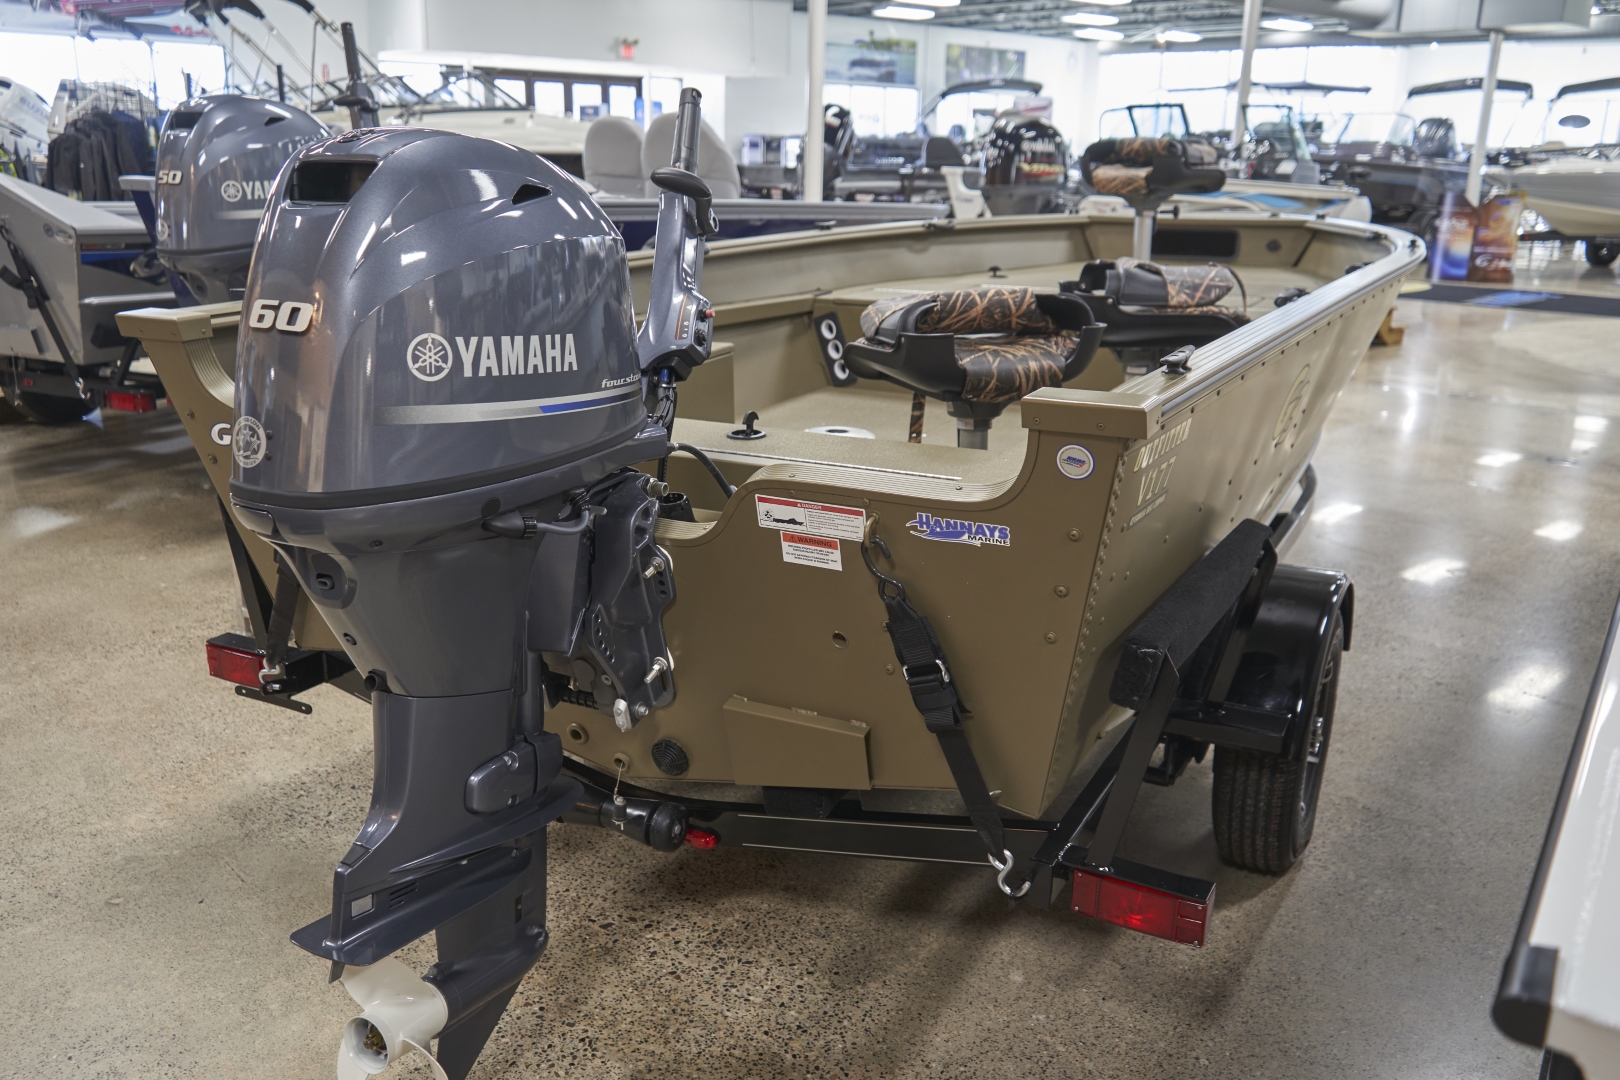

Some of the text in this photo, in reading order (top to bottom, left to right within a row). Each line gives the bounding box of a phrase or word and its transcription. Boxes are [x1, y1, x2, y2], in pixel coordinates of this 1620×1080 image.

[158, 170, 182, 185] 50
[242, 180, 275, 200] YAM
[249, 299, 314, 332] 60
[455, 333, 578, 378] YAMAHA
[211, 422, 232, 446] G
[1133, 417, 1193, 473] OUTFITTER
[916, 511, 1010, 540] HANNAYS
[797, 536, 833, 548] WARNING
[967, 534, 1011, 546] MARINE
